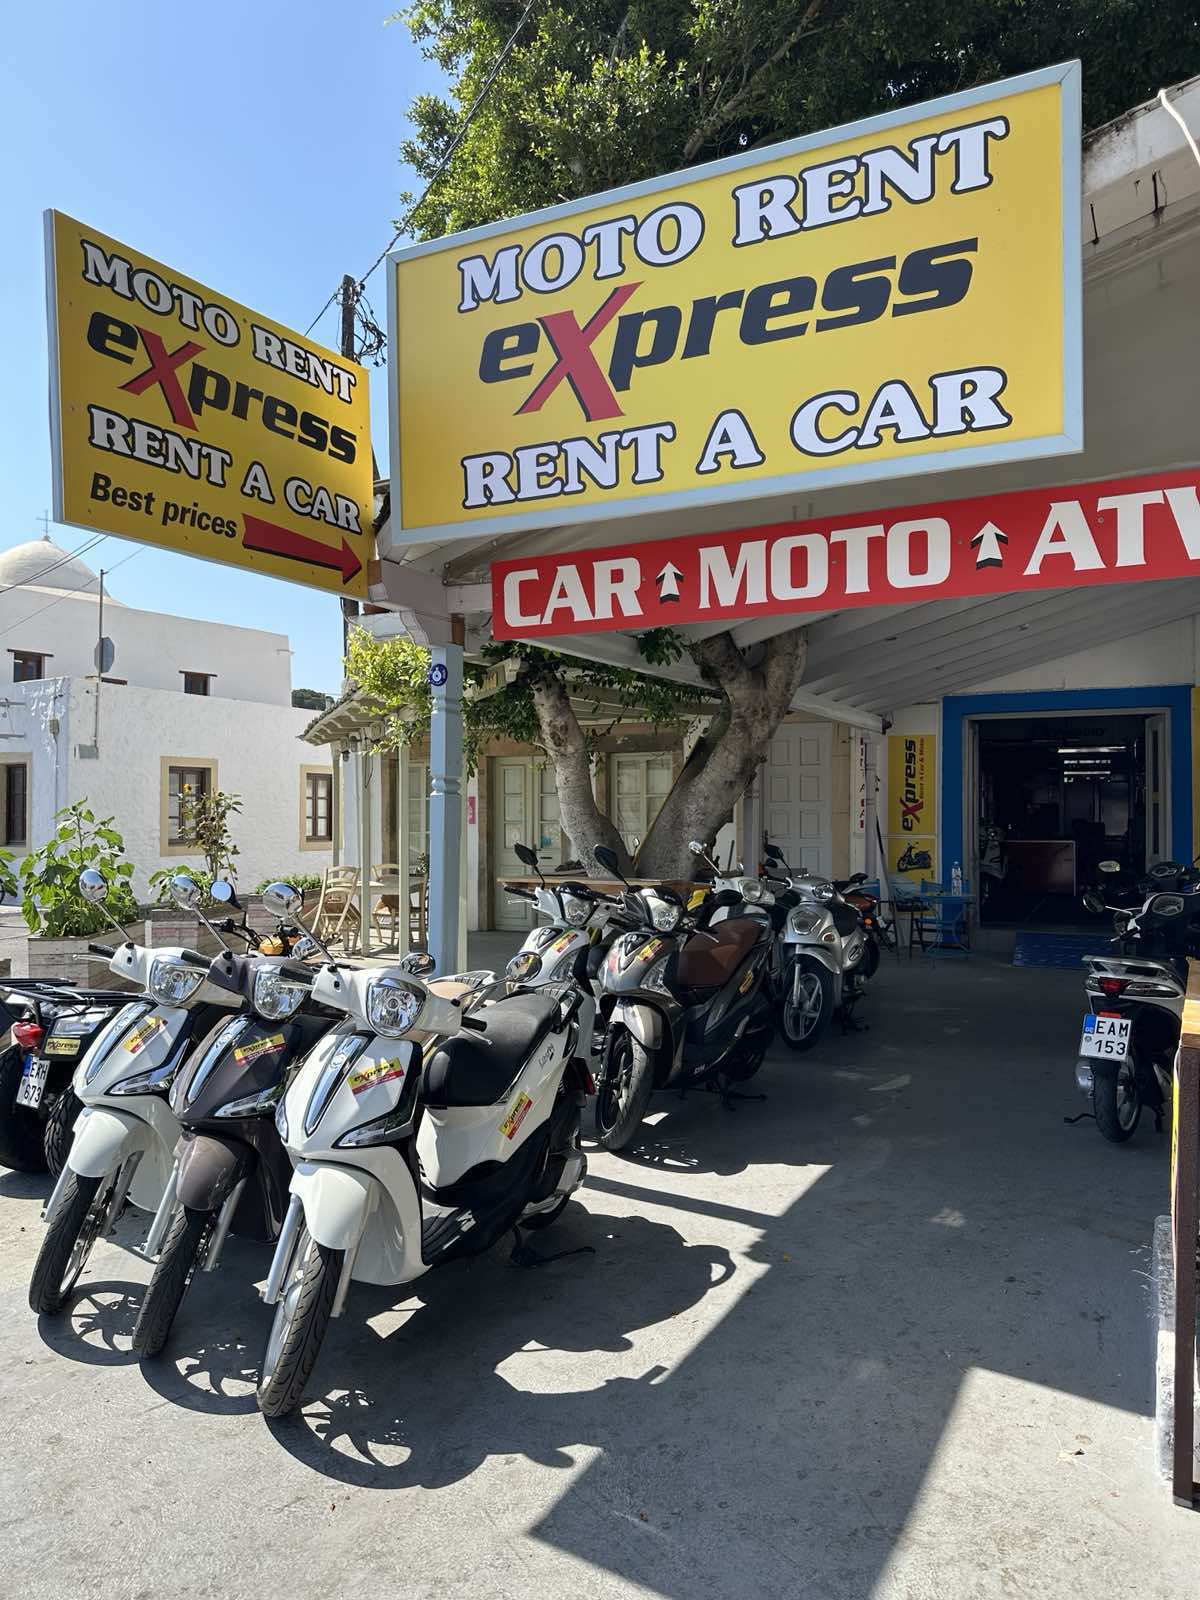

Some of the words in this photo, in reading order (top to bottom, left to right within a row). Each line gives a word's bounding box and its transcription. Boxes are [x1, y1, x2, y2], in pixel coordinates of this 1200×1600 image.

[457, 200, 705, 313] MOTO
[732, 115, 1010, 248] RENT
[80, 239, 242, 347] MOTO
[251, 322, 357, 405] RENT
[479, 237, 979, 421] eXpress
[86, 310, 358, 465] eXpress
[461, 421, 676, 511] RENT
[696, 408, 766, 476] A
[790, 365, 1013, 456] CAR
[87, 404, 233, 488] RENT
[240, 462, 276, 504] A
[283, 477, 364, 536] CAR
[90, 471, 156, 518] Best
[161, 500, 238, 540] prices
[503, 556, 643, 628] CAR
[698, 516, 952, 611] MOTO
[900, 738, 925, 832] eXpress
[1095, 1040, 1126, 1055] 153
[1096, 1021, 1129, 1037] EAM
[24, 1084, 41, 1103] 673
